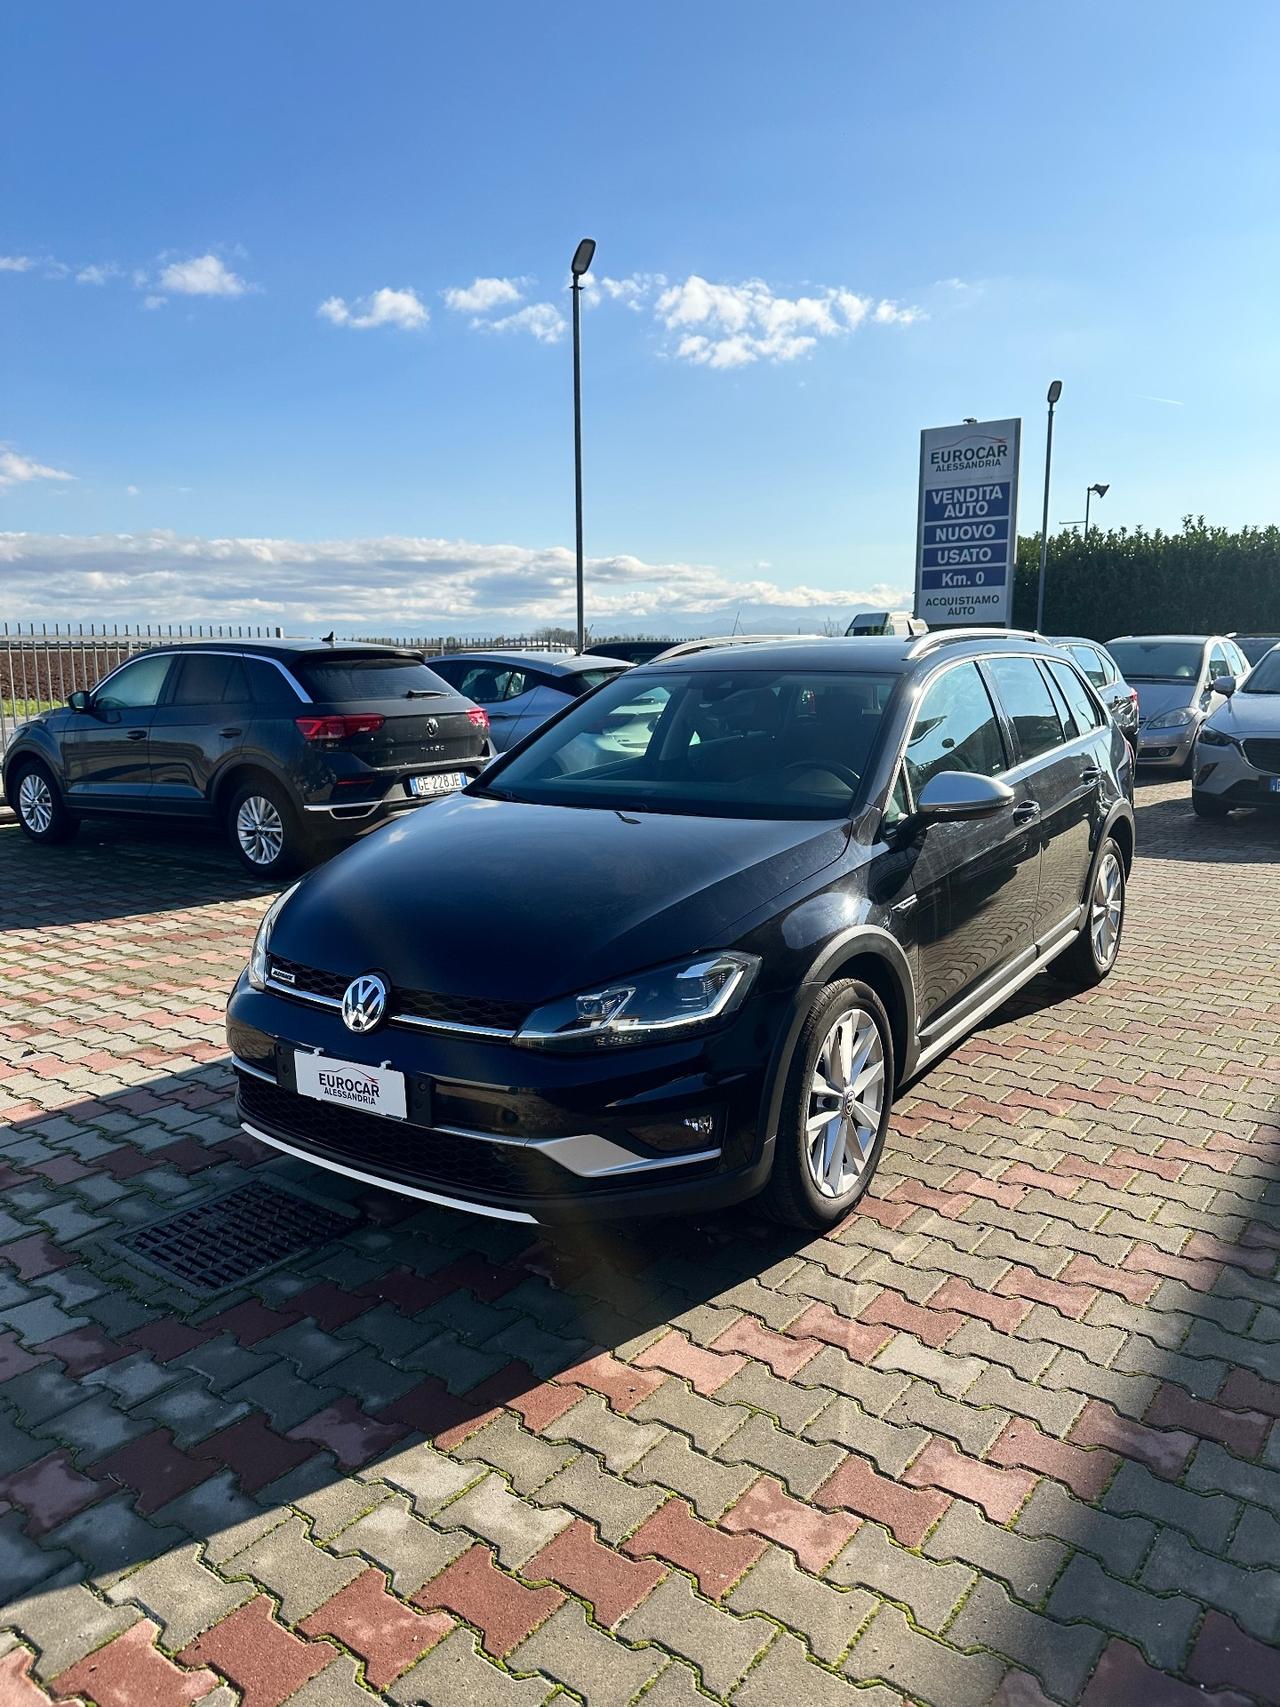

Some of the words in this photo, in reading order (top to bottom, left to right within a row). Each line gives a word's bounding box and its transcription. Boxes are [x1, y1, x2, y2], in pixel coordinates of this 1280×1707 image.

[931, 444, 1008, 465] EUROCAR
[935, 459, 1001, 473] ALESSANDRIA
[932, 485, 1003, 505] VENDITA
[944, 501, 988, 518] AUTO
[935, 524, 995, 542] NUOVO
[937, 547, 992, 564] USATO
[941, 572, 972, 587] Km.
[975, 571, 985, 584] 0
[925, 594, 1000, 607] ACQUISTIAMO
[947, 606, 975, 616] AUTO
[318, 1072, 380, 1097] EUROCAR
[323, 1086, 377, 1105] ALESSANDRIA
